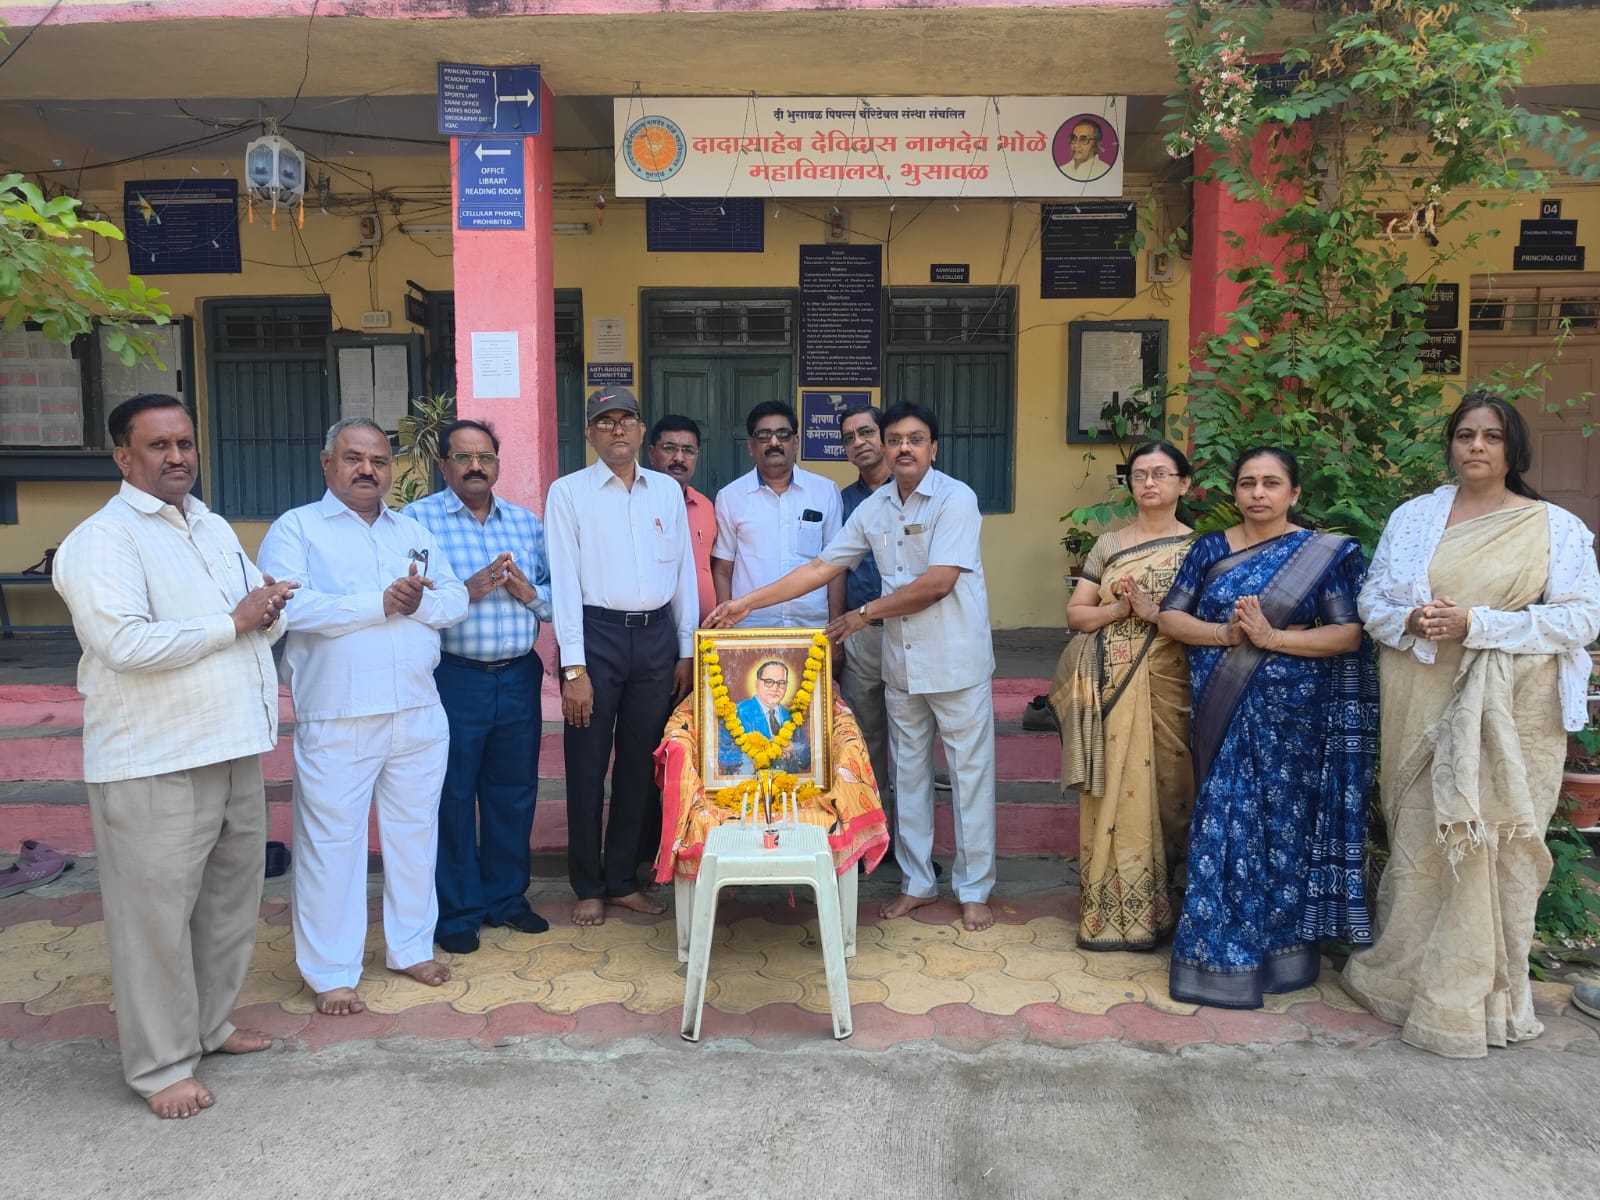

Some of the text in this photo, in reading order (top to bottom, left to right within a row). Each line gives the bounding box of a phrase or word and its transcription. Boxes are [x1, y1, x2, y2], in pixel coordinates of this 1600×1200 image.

[773, 107, 784, 121] दी
[786, 109, 823, 124] भुसावळ
[901, 106, 927, 120] संस्था
[928, 106, 967, 120] संचलित
[691, 129, 1049, 155] दादासाहेब देविदास नामदेव भोळे
[748, 157, 990, 187] महाविद्यालय, भुसावळ
[478, 177, 508, 185] LIBRARY
[465, 187, 522, 195] READING ROOM
[1543, 204, 1558, 215] 04
[810, 413, 834, 425] आपण
